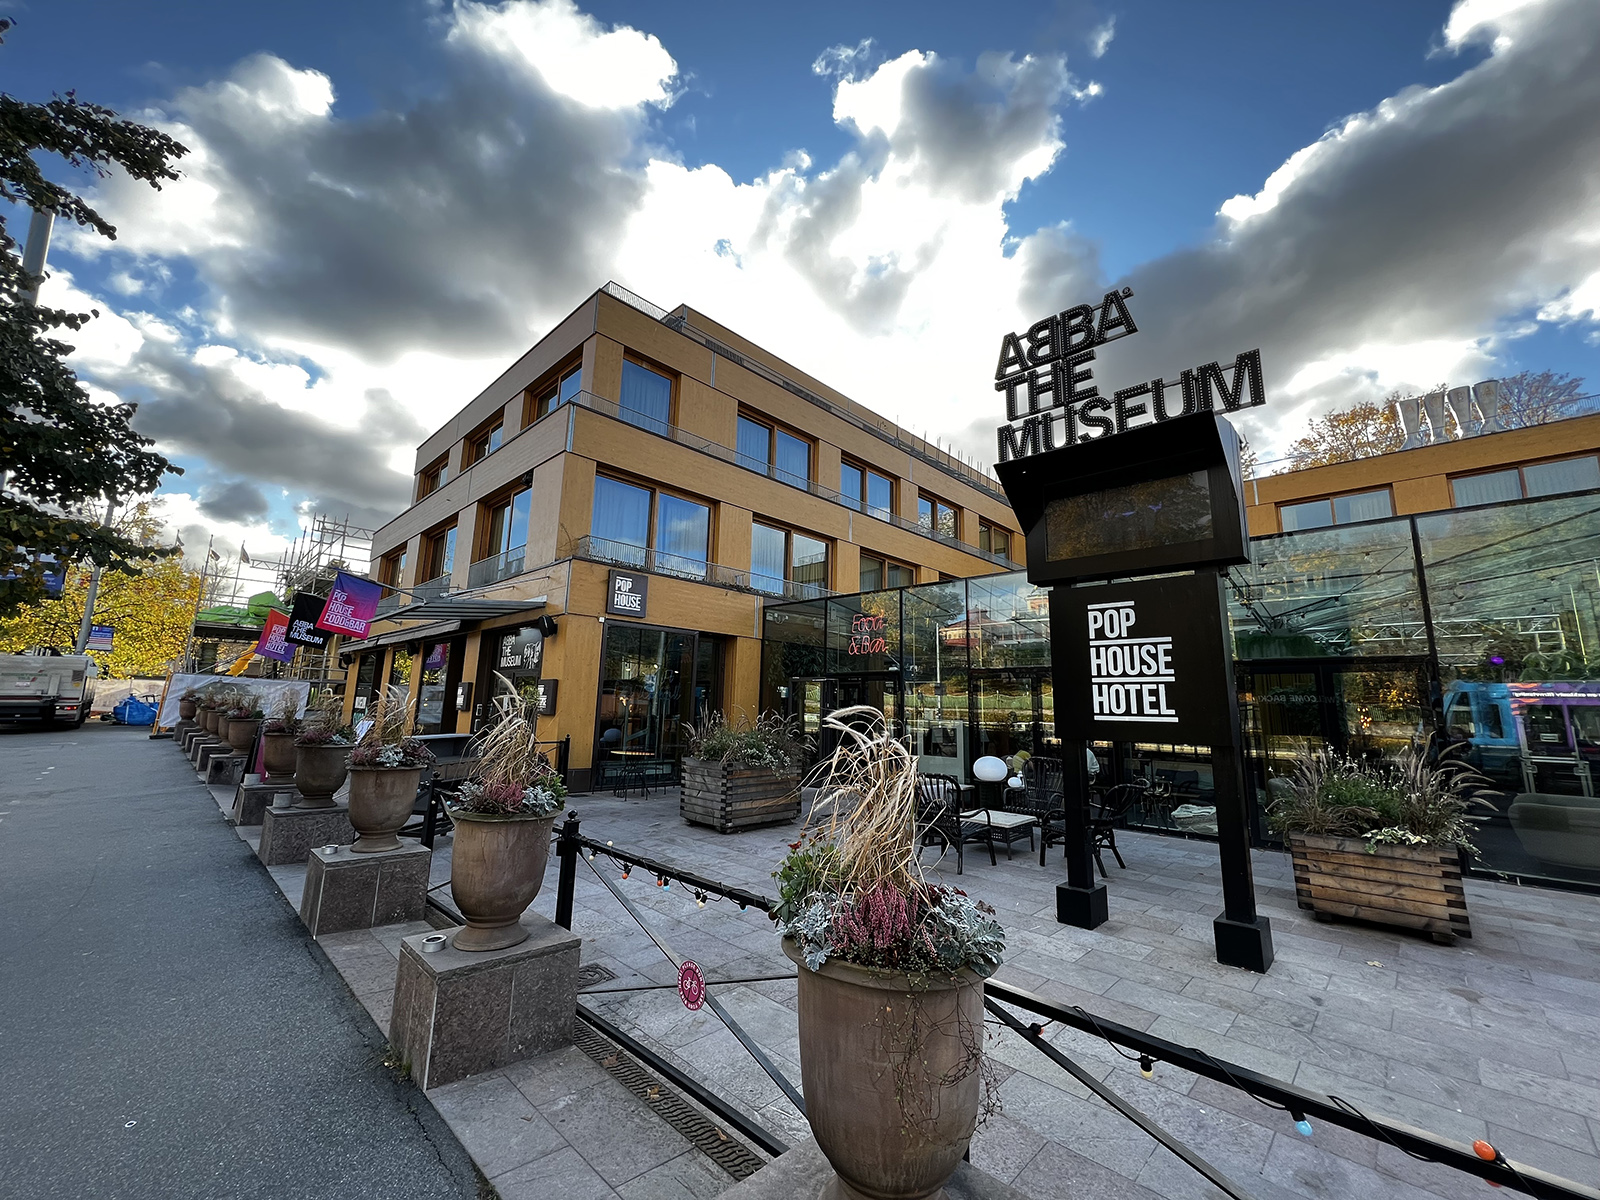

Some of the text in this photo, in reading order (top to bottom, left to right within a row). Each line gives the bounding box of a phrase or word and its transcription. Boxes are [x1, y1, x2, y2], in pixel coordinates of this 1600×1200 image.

[995, 348, 1100, 422] THE
[996, 347, 1267, 463] MUSEUM
[615, 579, 633, 592] POP
[332, 591, 348, 603] POP
[614, 593, 642, 608] HOUSE
[328, 602, 354, 617] HOUSE
[292, 619, 314, 630] ABBA
[1087, 608, 1136, 639] POP
[289, 631, 324, 645] MUSEUM
[502, 646, 512, 656] THE
[500, 655, 521, 668] MUSEUM
[1089, 644, 1175, 676] HOUSE
[1092, 683, 1176, 715] HOTEL
